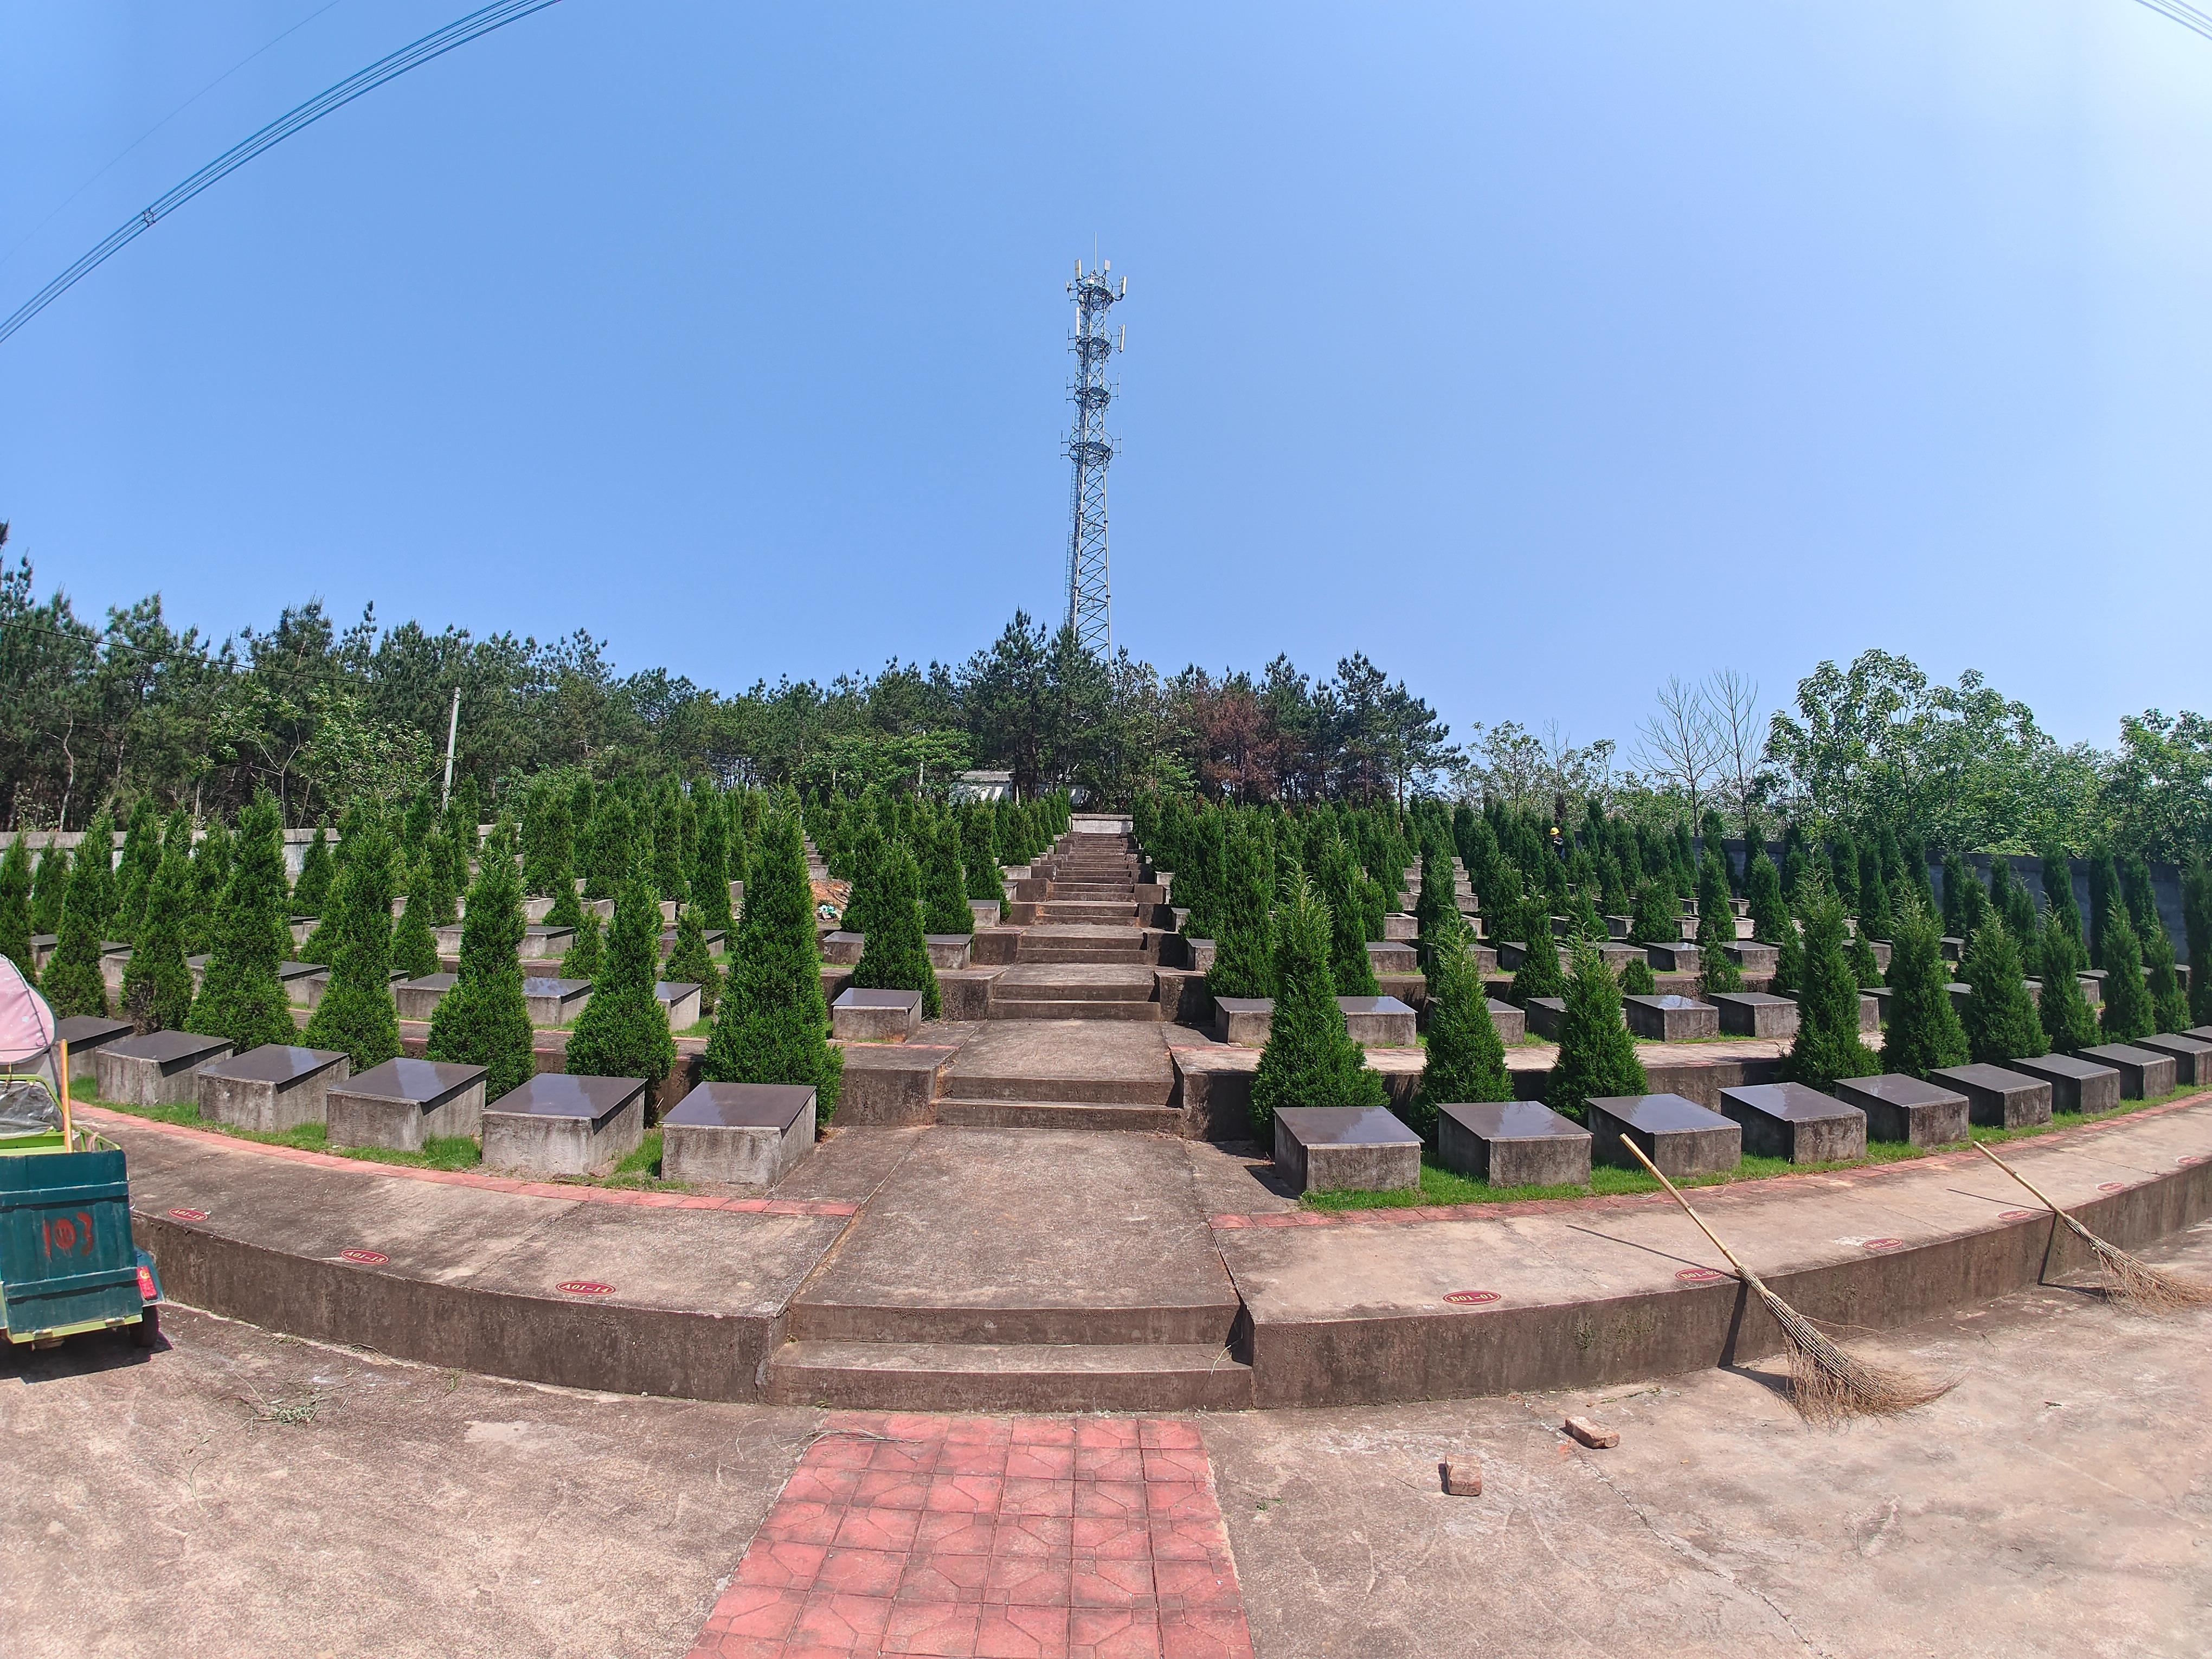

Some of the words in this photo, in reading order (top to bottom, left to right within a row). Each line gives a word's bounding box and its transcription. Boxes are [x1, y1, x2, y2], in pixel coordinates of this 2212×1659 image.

[43, 1212, 93, 1259] 103
[344, 1251, 385, 1262] A01-13
[1680, 1270, 1720, 1278] B01-02
[561, 1283, 609, 1293] A01-14
[1449, 1293, 1495, 1302] B01-01
